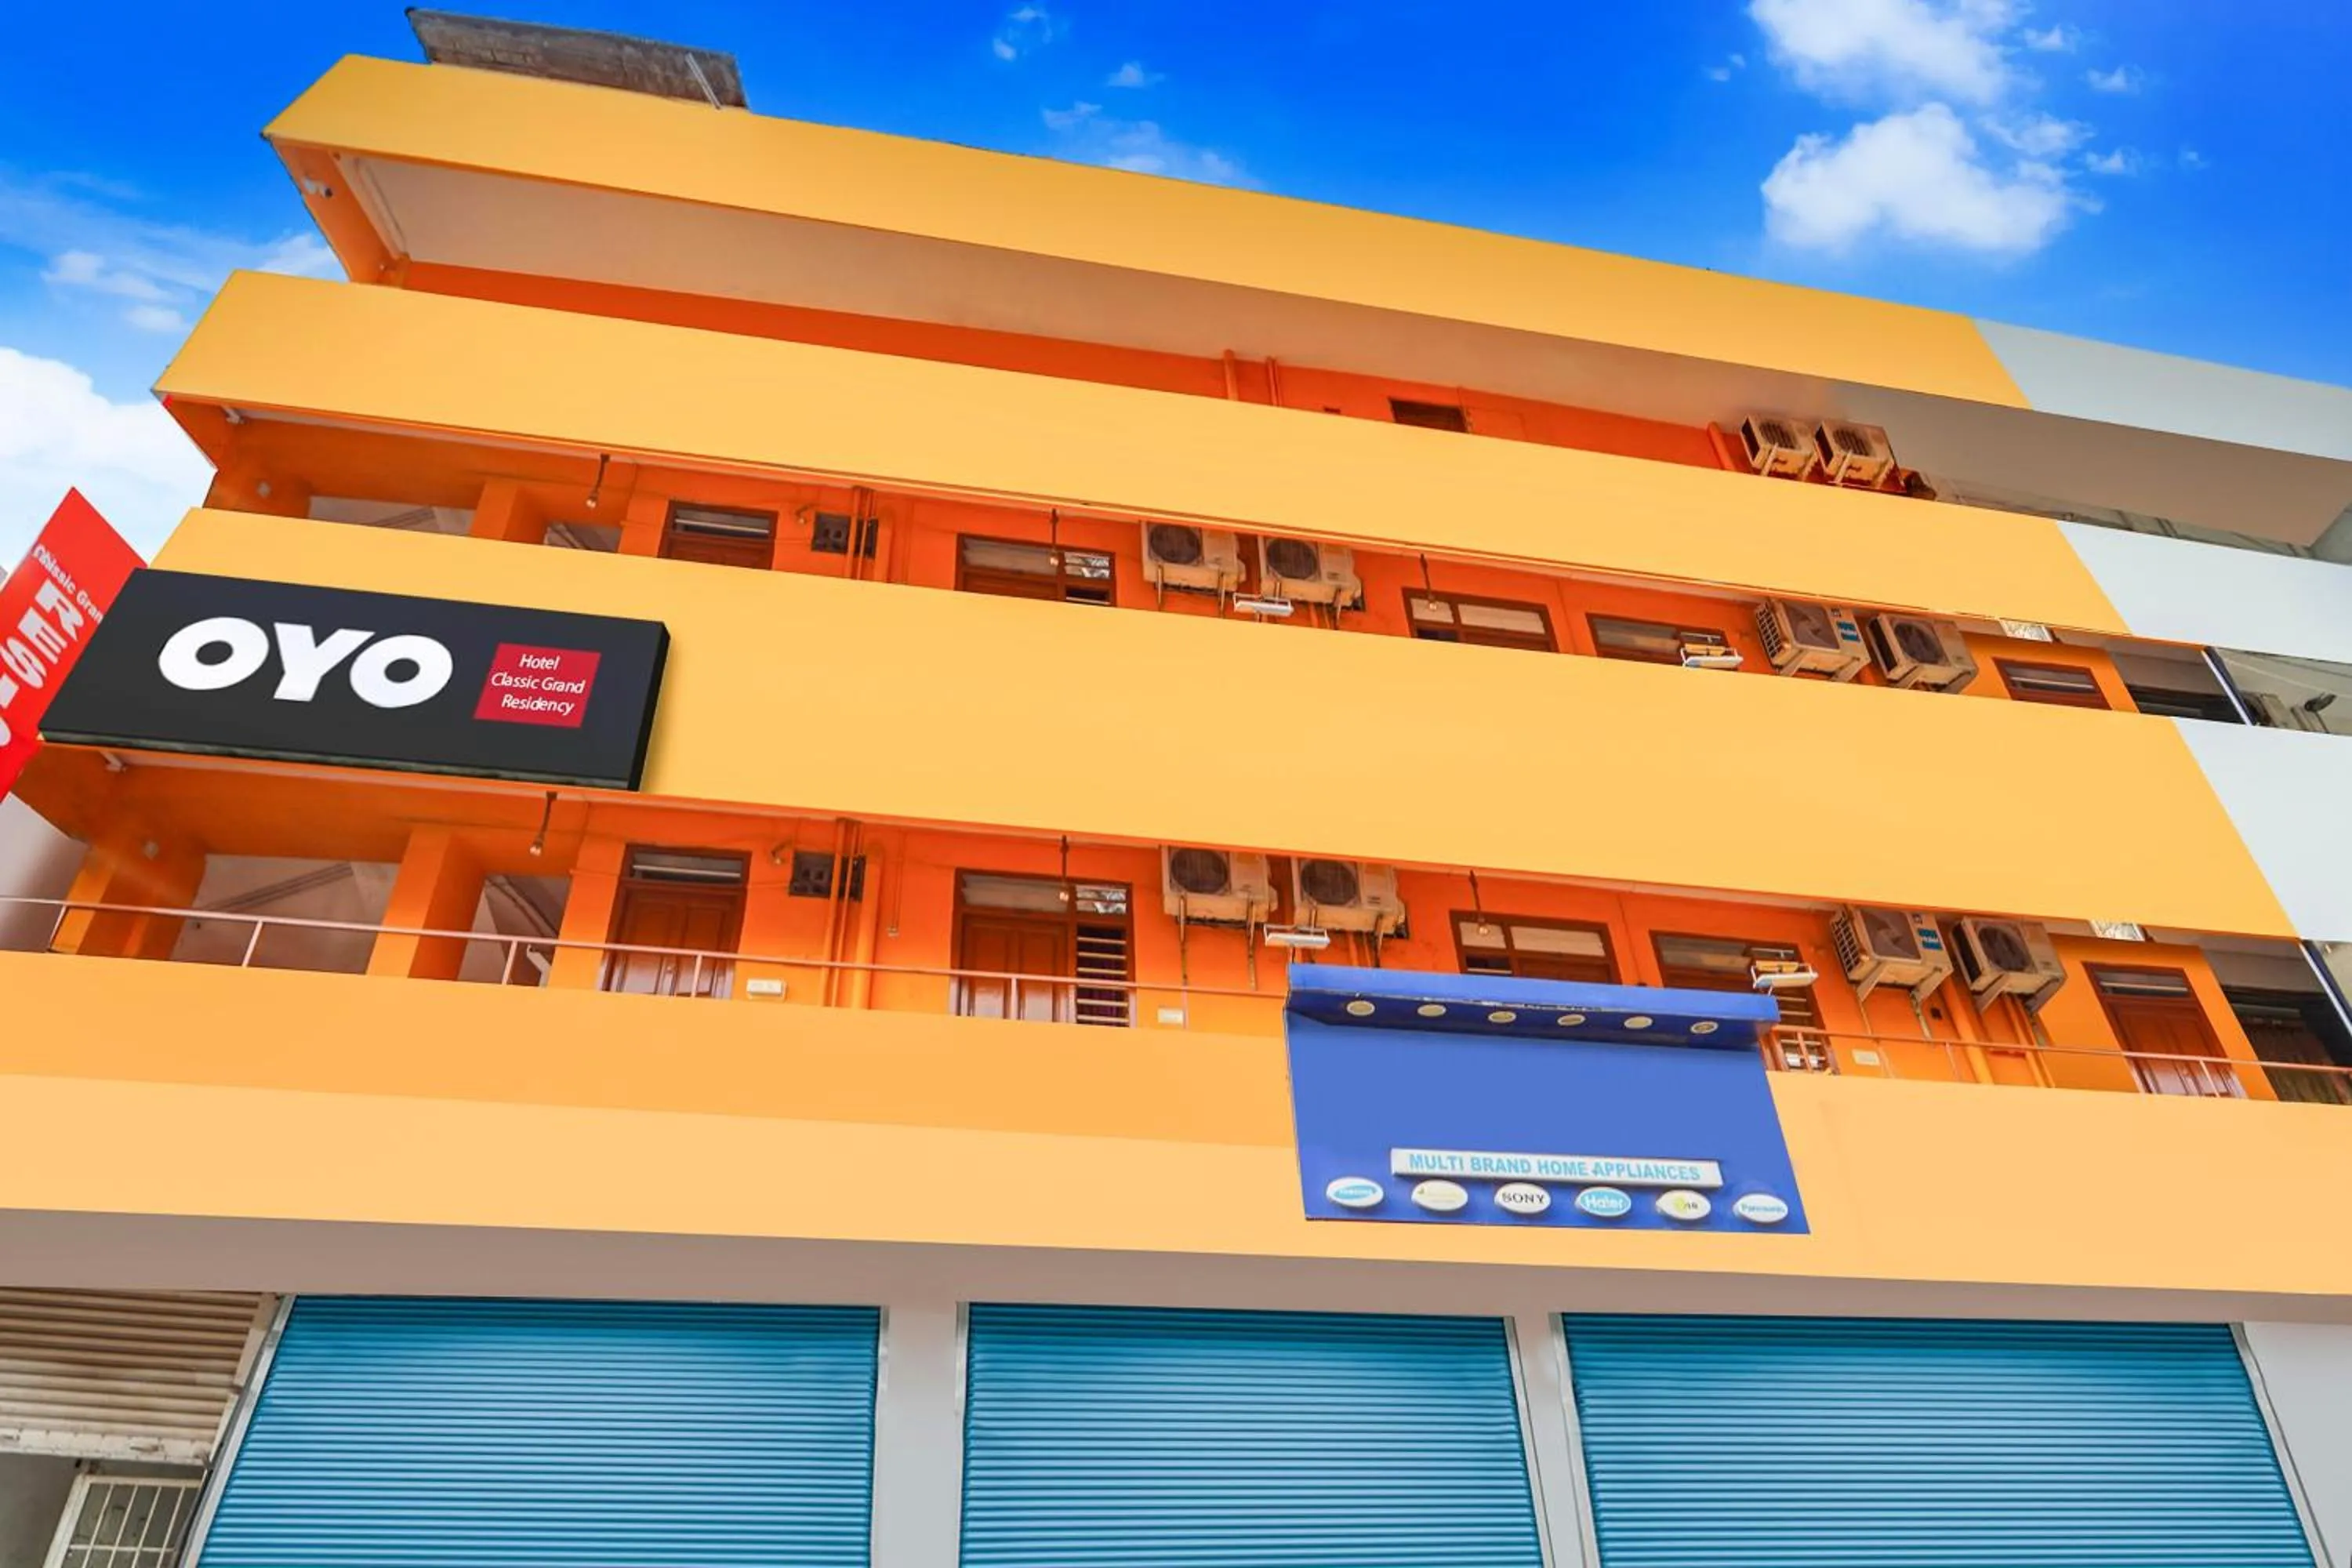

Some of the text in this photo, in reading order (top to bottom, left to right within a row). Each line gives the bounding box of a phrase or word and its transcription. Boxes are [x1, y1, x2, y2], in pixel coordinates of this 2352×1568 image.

[158, 616, 453, 708] OYO
[519, 653, 561, 671] Hotel
[491, 672, 586, 694] Classic Grand
[501, 693, 575, 717] Residency
[1410, 1153, 1701, 1181] MULTI BRAND HOME APPLIANCES
[1501, 1192, 1545, 1204] SONY
